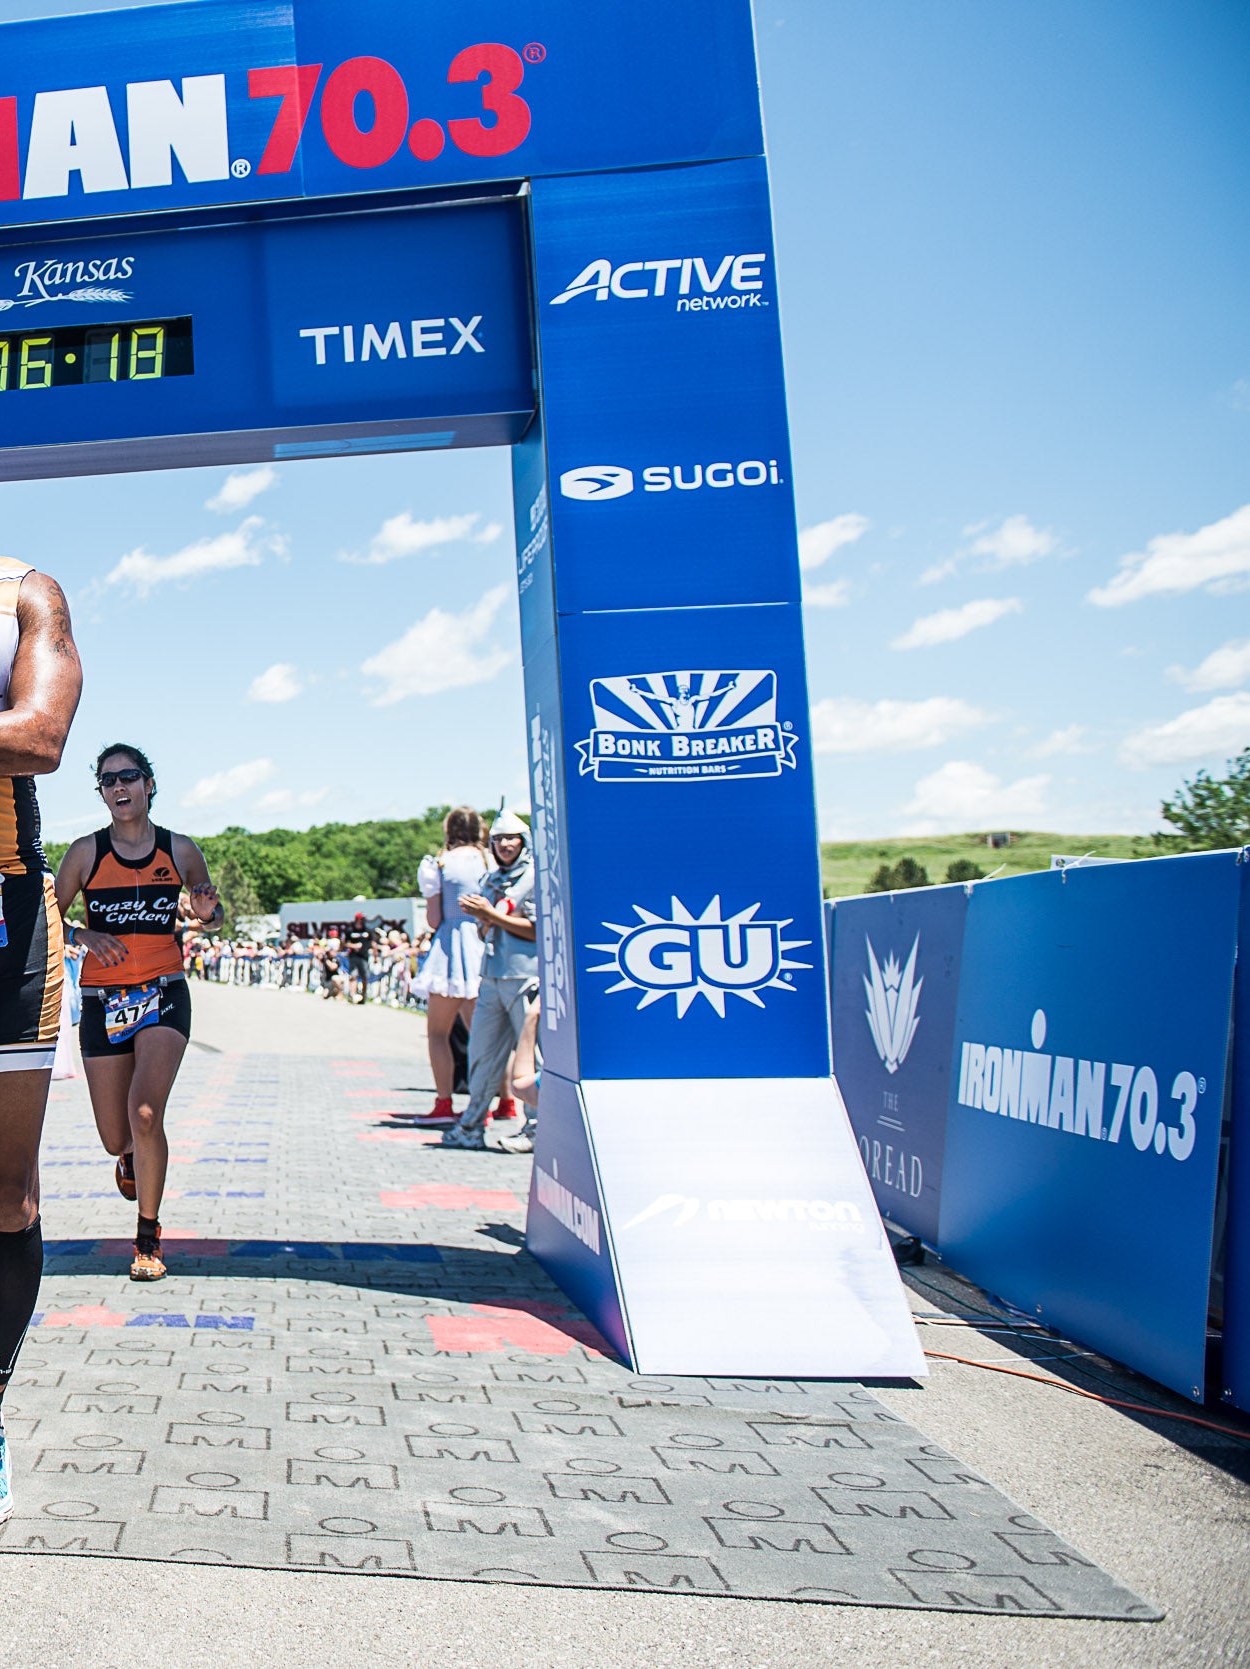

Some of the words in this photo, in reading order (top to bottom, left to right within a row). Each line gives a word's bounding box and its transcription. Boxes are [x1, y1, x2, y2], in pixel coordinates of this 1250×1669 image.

[248, 43, 532, 175] 70.3
[14, 257, 134, 299] Kansas
[550, 253, 765, 305] ACTIVE
[676, 293, 762, 312] network
[299, 315, 485, 365] TIMEX
[597, 733, 662, 757] BONK
[671, 728, 776, 757] BREAKER
[648, 766, 700, 776] NUTRITION
[701, 764, 727, 774] BARS
[89, 900, 146, 913] Crazy
[105, 909, 170, 924] Cyclery
[624, 927, 774, 985] GU
[958, 1009, 1106, 1141] IRONMAN
[1108, 1063, 1197, 1162] 70.3
